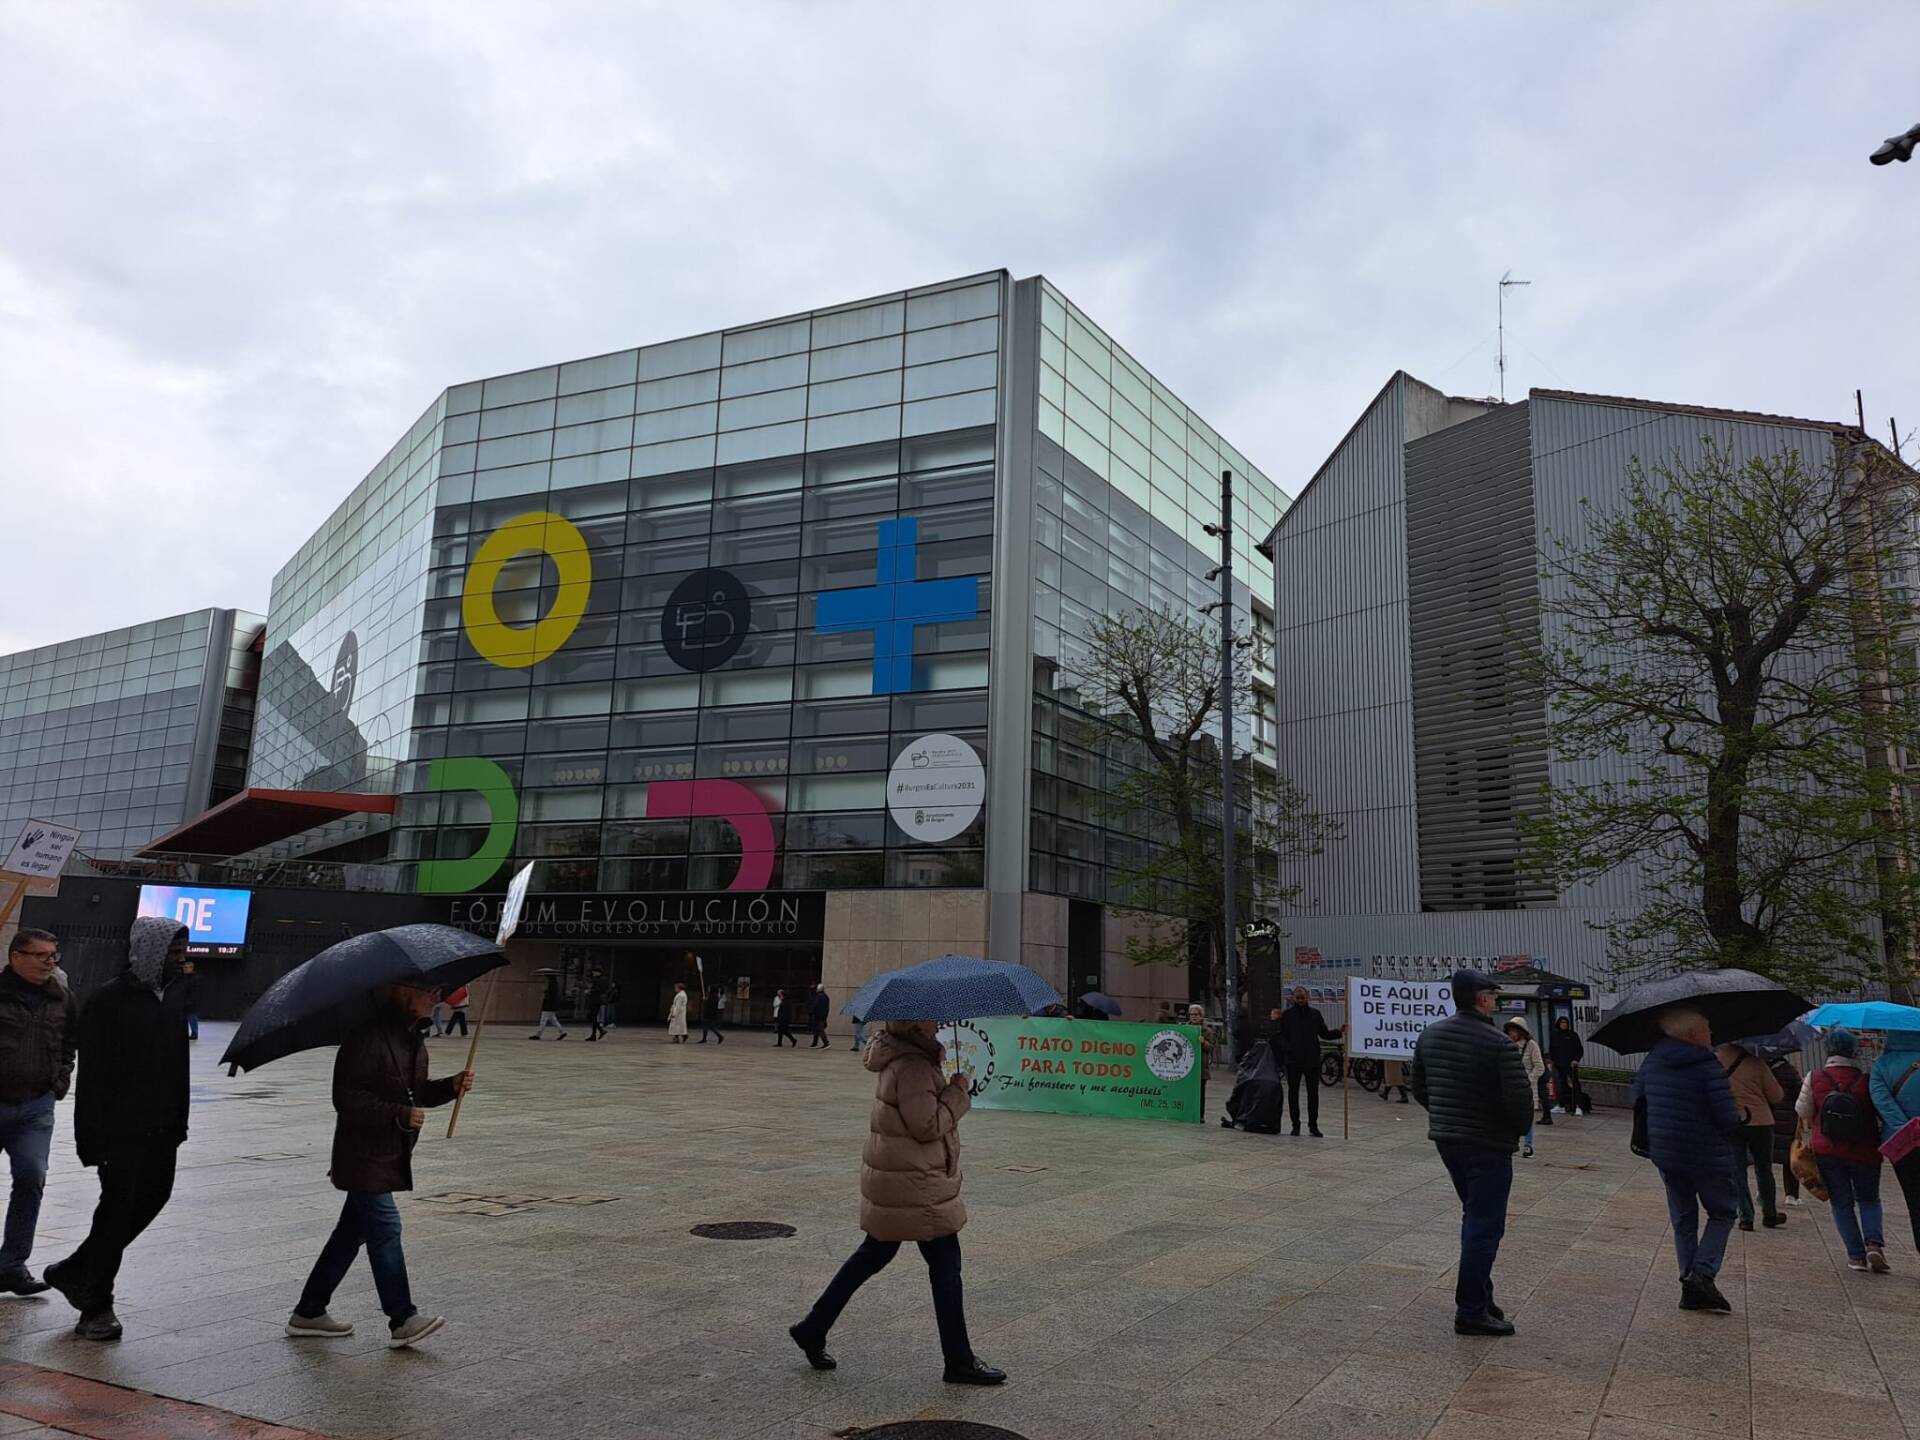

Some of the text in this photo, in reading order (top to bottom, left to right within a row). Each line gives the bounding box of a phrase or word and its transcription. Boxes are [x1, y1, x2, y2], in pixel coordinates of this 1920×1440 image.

[175, 897, 216, 931] DE
[581, 893, 799, 923] EVOLUCIÓN
[526, 922, 545, 934] DE
[554, 922, 660, 934] CONGRESOS
[673, 921, 681, 934] Y
[692, 921, 798, 934] AUDITORIO
[1360, 984, 1382, 999] DE
[1387, 984, 1429, 1000] AQUÍ
[1438, 987, 1451, 1001] O
[1363, 1001, 1448, 1017] DE FUERA
[1375, 1019, 1427, 1033] Justici
[1018, 1037, 1073, 1053] TRATO
[1080, 1040, 1137, 1057] DIGNO
[1364, 1038, 1399, 1050] para
[1021, 1058, 1133, 1078] PARA TODOS
[1028, 1076, 1076, 1092] forastero
[1080, 1083, 1086, 1095] y
[1091, 1084, 1106, 1092] me
